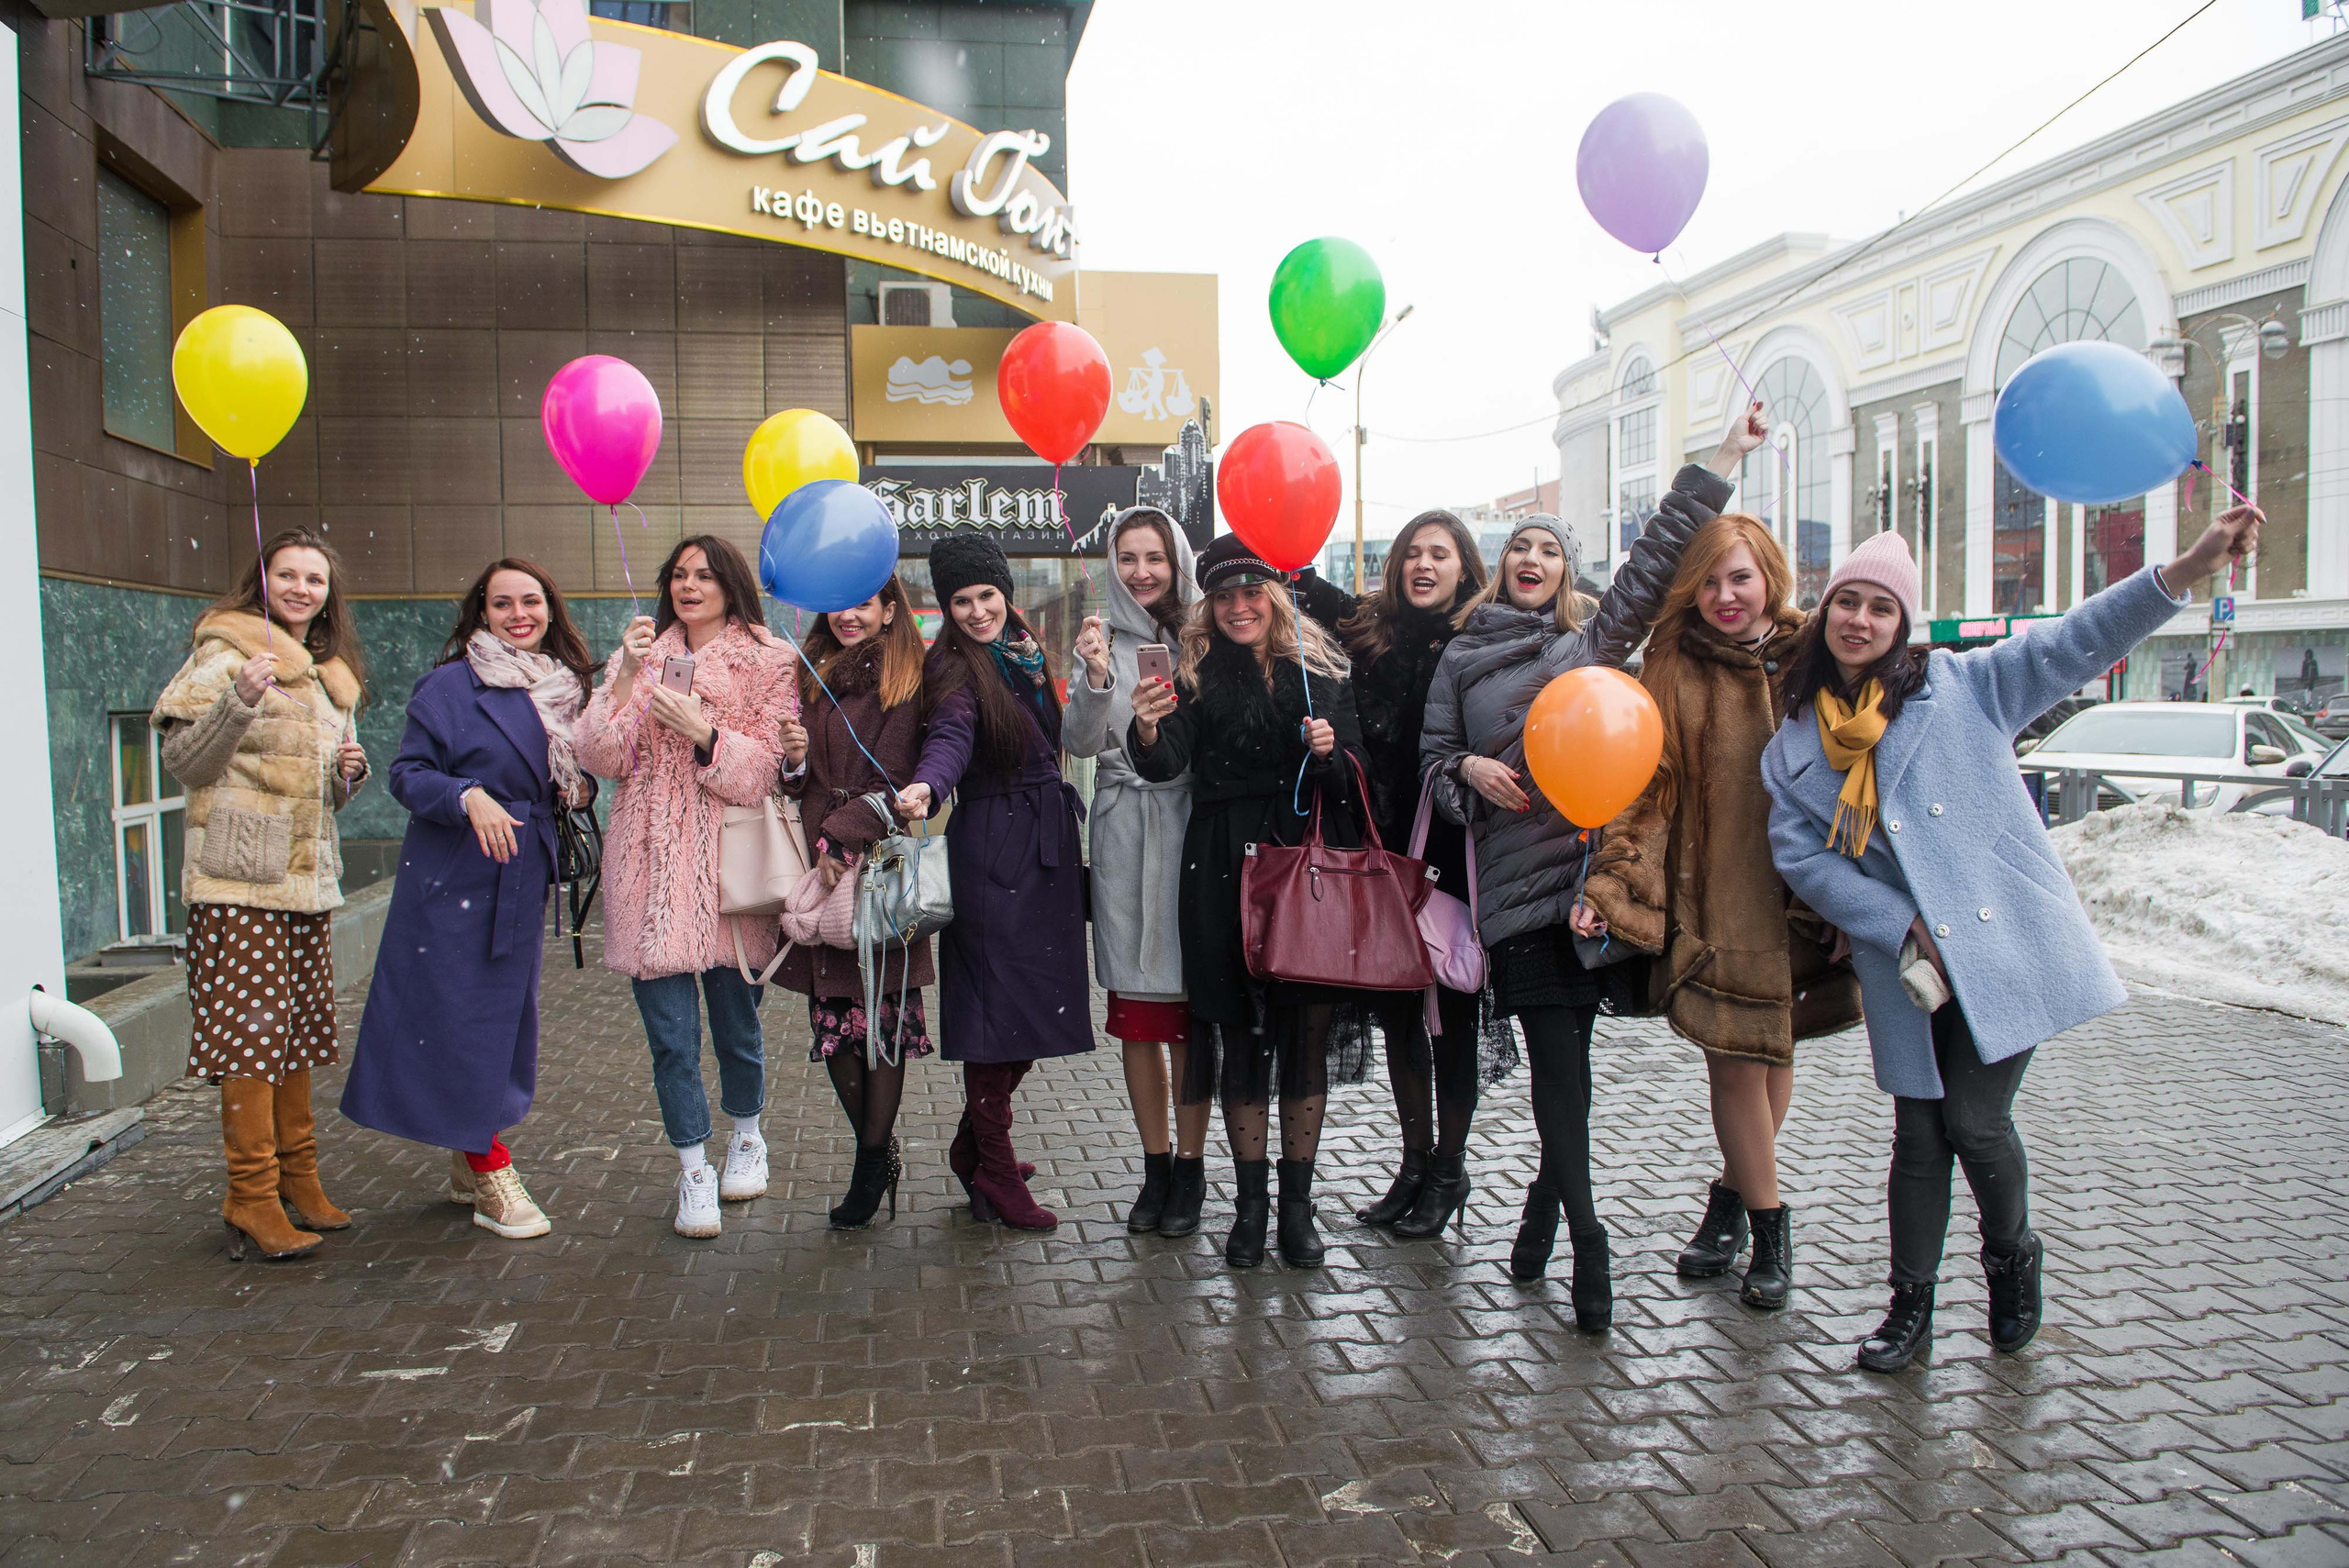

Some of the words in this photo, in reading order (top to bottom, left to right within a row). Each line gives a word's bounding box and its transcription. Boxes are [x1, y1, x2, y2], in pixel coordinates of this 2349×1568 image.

[702, 40, 950, 191] Сай
[751, 185, 845, 230] кафе
[852, 208, 1010, 282] вьетнамской
[1011, 261, 1053, 303] кухни
[970, 530, 1065, 540] АГАЗИН
[2219, 599, 2232, 619] P
